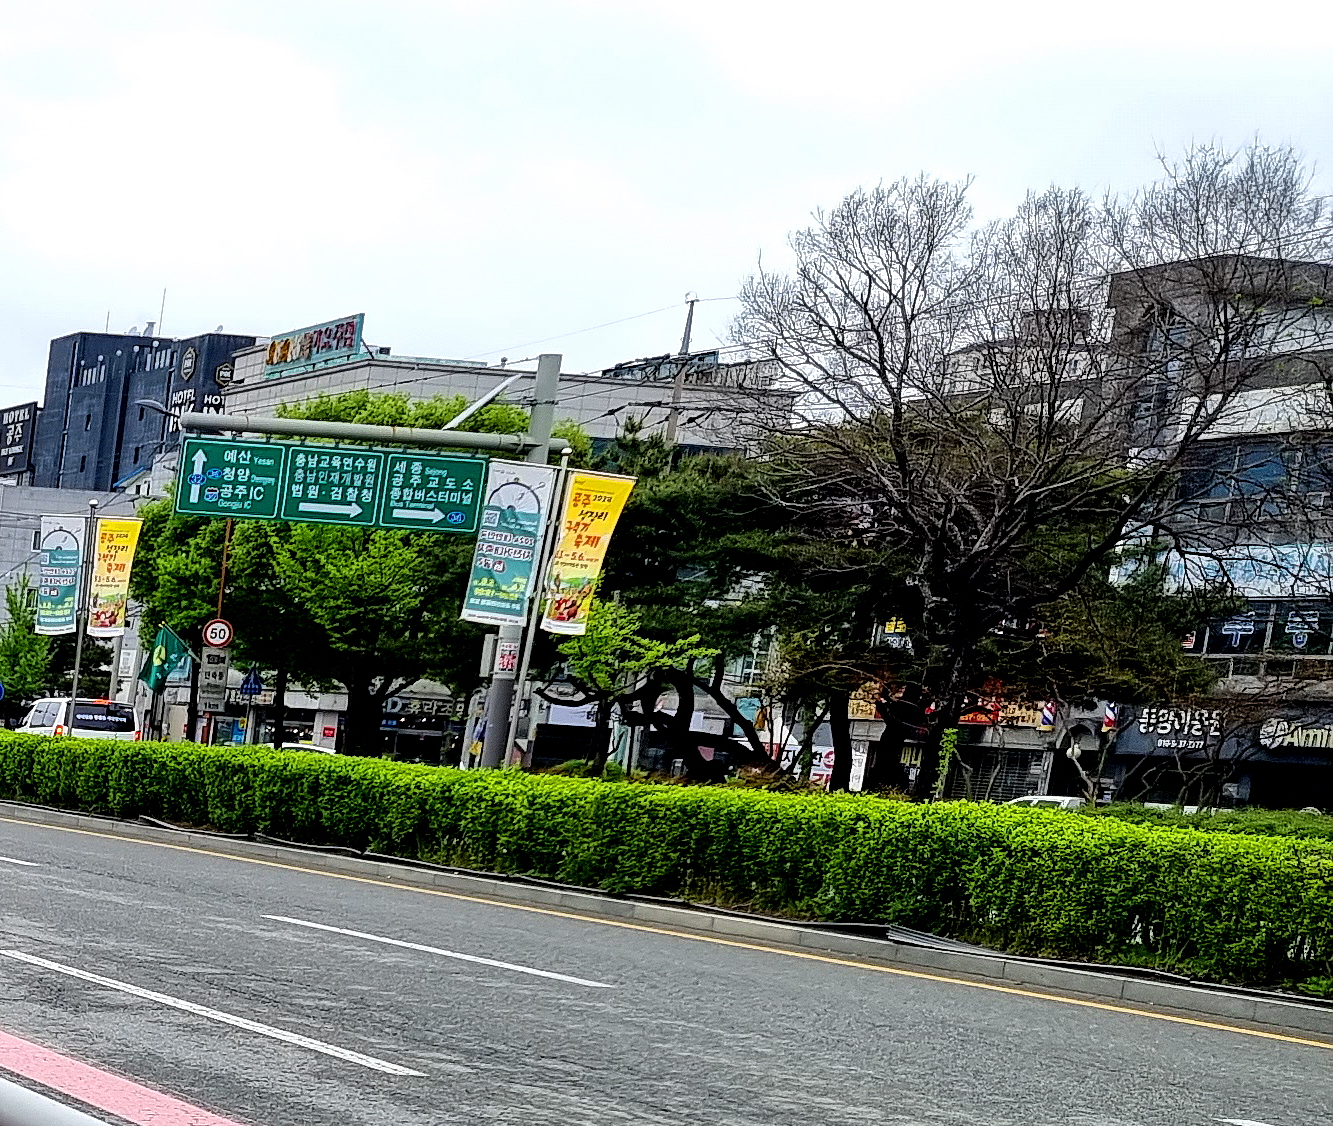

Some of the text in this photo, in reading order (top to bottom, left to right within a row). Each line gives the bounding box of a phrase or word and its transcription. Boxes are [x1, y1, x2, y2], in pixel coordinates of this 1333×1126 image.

[2, 408, 30, 425] HOTEL
[6, 422, 24, 446] 공주
[223, 449, 252, 464] 예산
[295, 452, 378, 473] 충남교육연수원
[222, 466, 250, 482] 청양
[293, 468, 376, 488] 충남인재개발원
[389, 486, 473, 505] 종합버스터미널
[573, 492, 592, 508] 공주
[100, 532, 115, 544] 공주
[573, 533, 602, 549] 축제
[209, 628, 226, 640] 50
